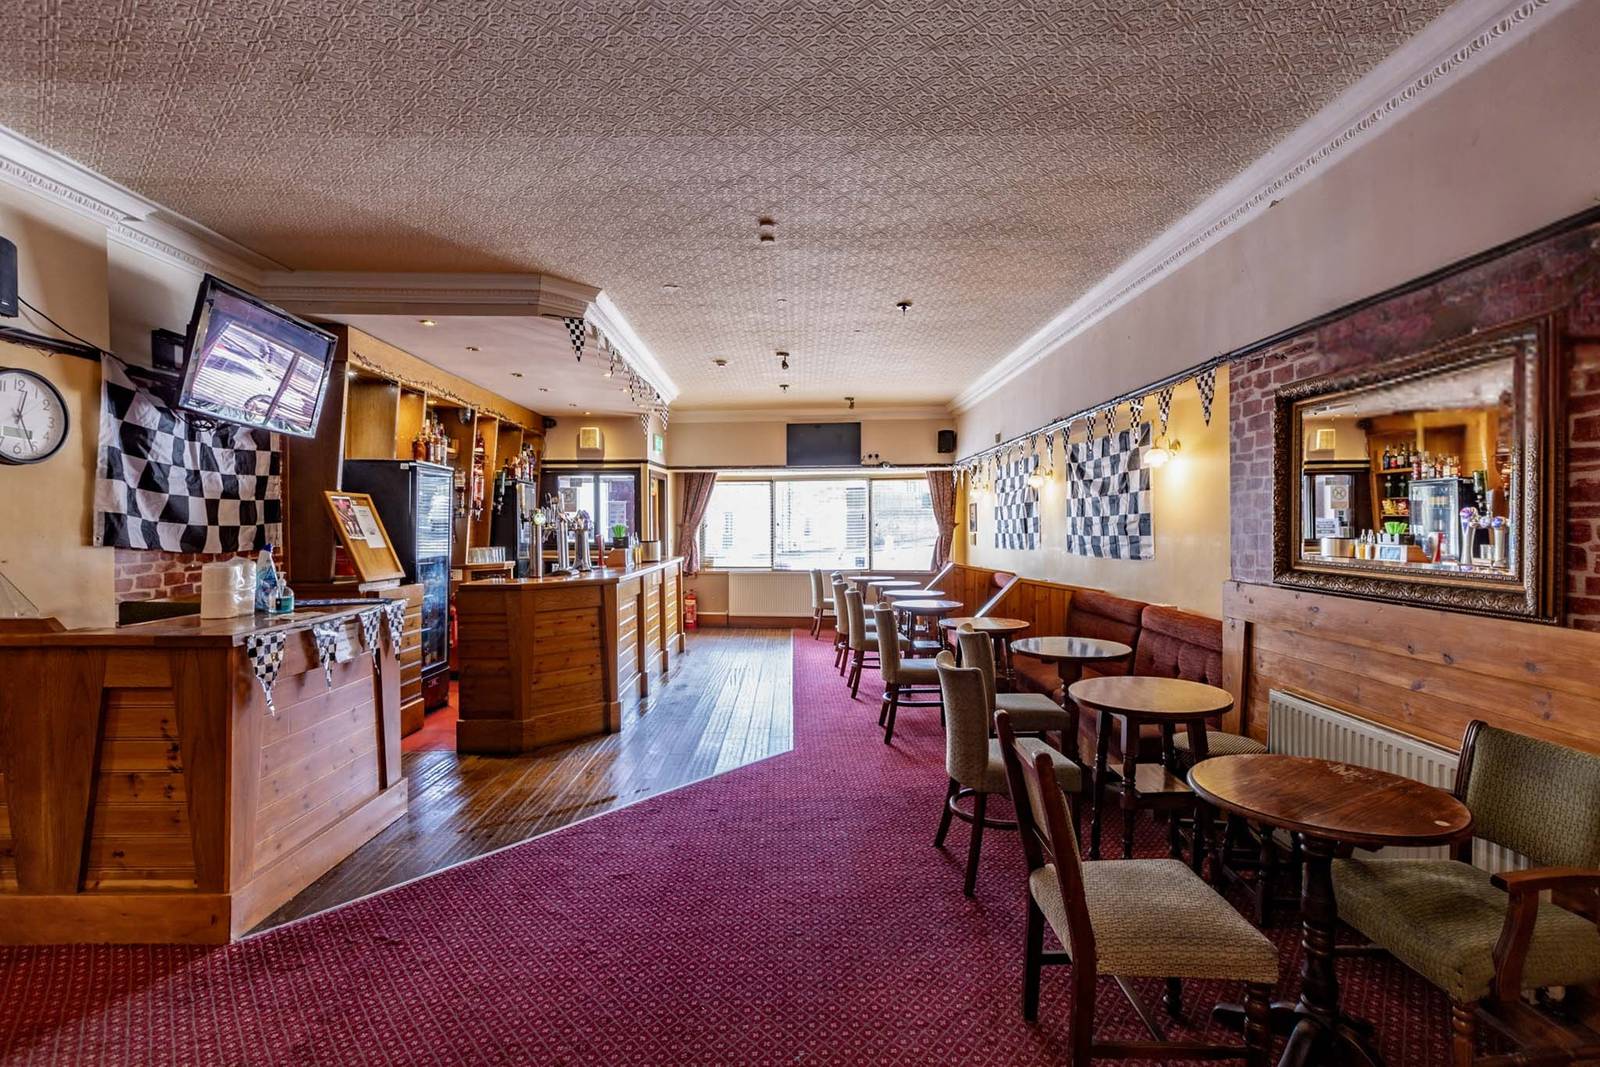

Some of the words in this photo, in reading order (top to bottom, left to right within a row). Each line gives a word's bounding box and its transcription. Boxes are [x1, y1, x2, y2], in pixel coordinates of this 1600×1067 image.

[14, 378, 26, 393] 12
[35, 387, 39, 399] 1
[43, 400, 50, 411] 2
[47, 417, 55, 429] 3
[43, 431, 50, 440] 4
[13, 442, 21, 454] 6
[30, 441, 38, 452] 5
